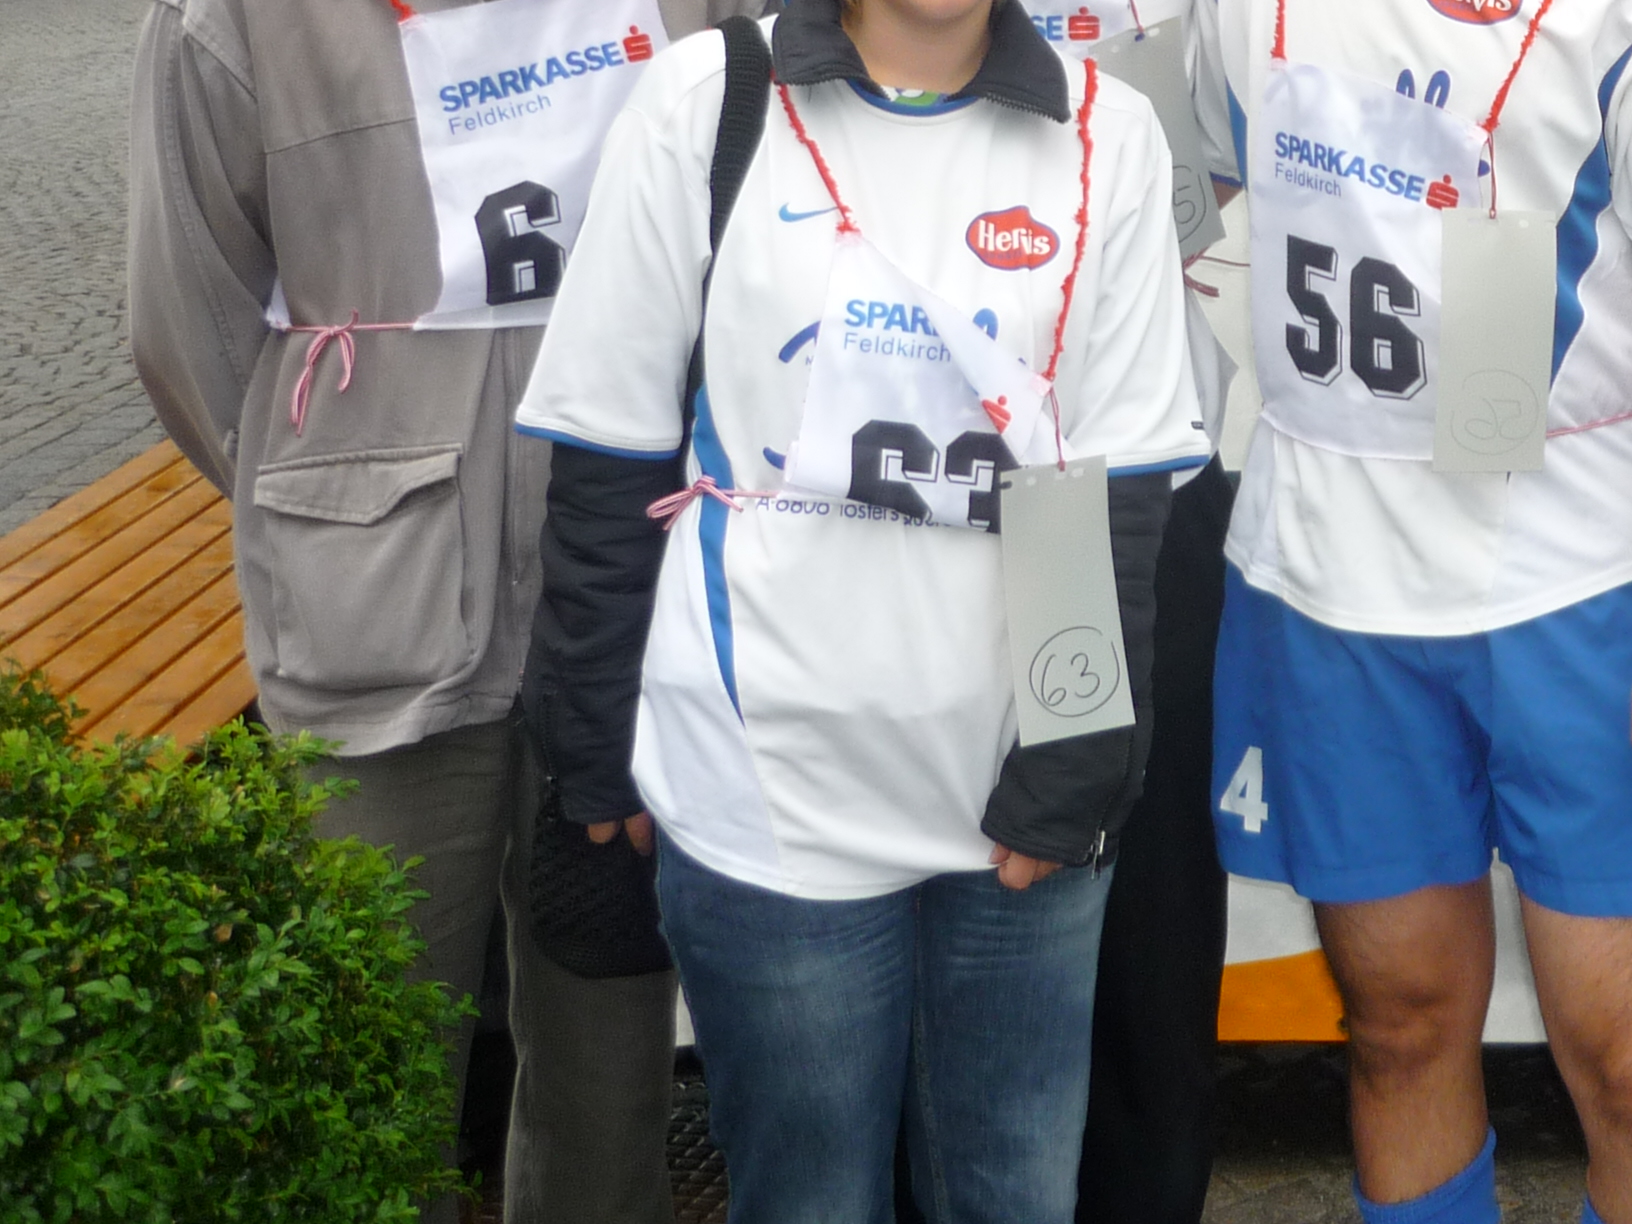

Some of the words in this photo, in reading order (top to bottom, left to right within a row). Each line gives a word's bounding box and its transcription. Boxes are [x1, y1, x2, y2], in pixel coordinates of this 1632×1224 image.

[438, 40, 626, 114] SPARKASSE
[447, 93, 553, 137] Feldkirch
[1273, 131, 1427, 205] SPARKASSE
[1274, 161, 1343, 199] Feldkirch
[843, 331, 952, 363] Feldkirch
[1285, 233, 1428, 401] 56
[1040, 652, 1101, 707] 63
[1219, 745, 1269, 834] 4
